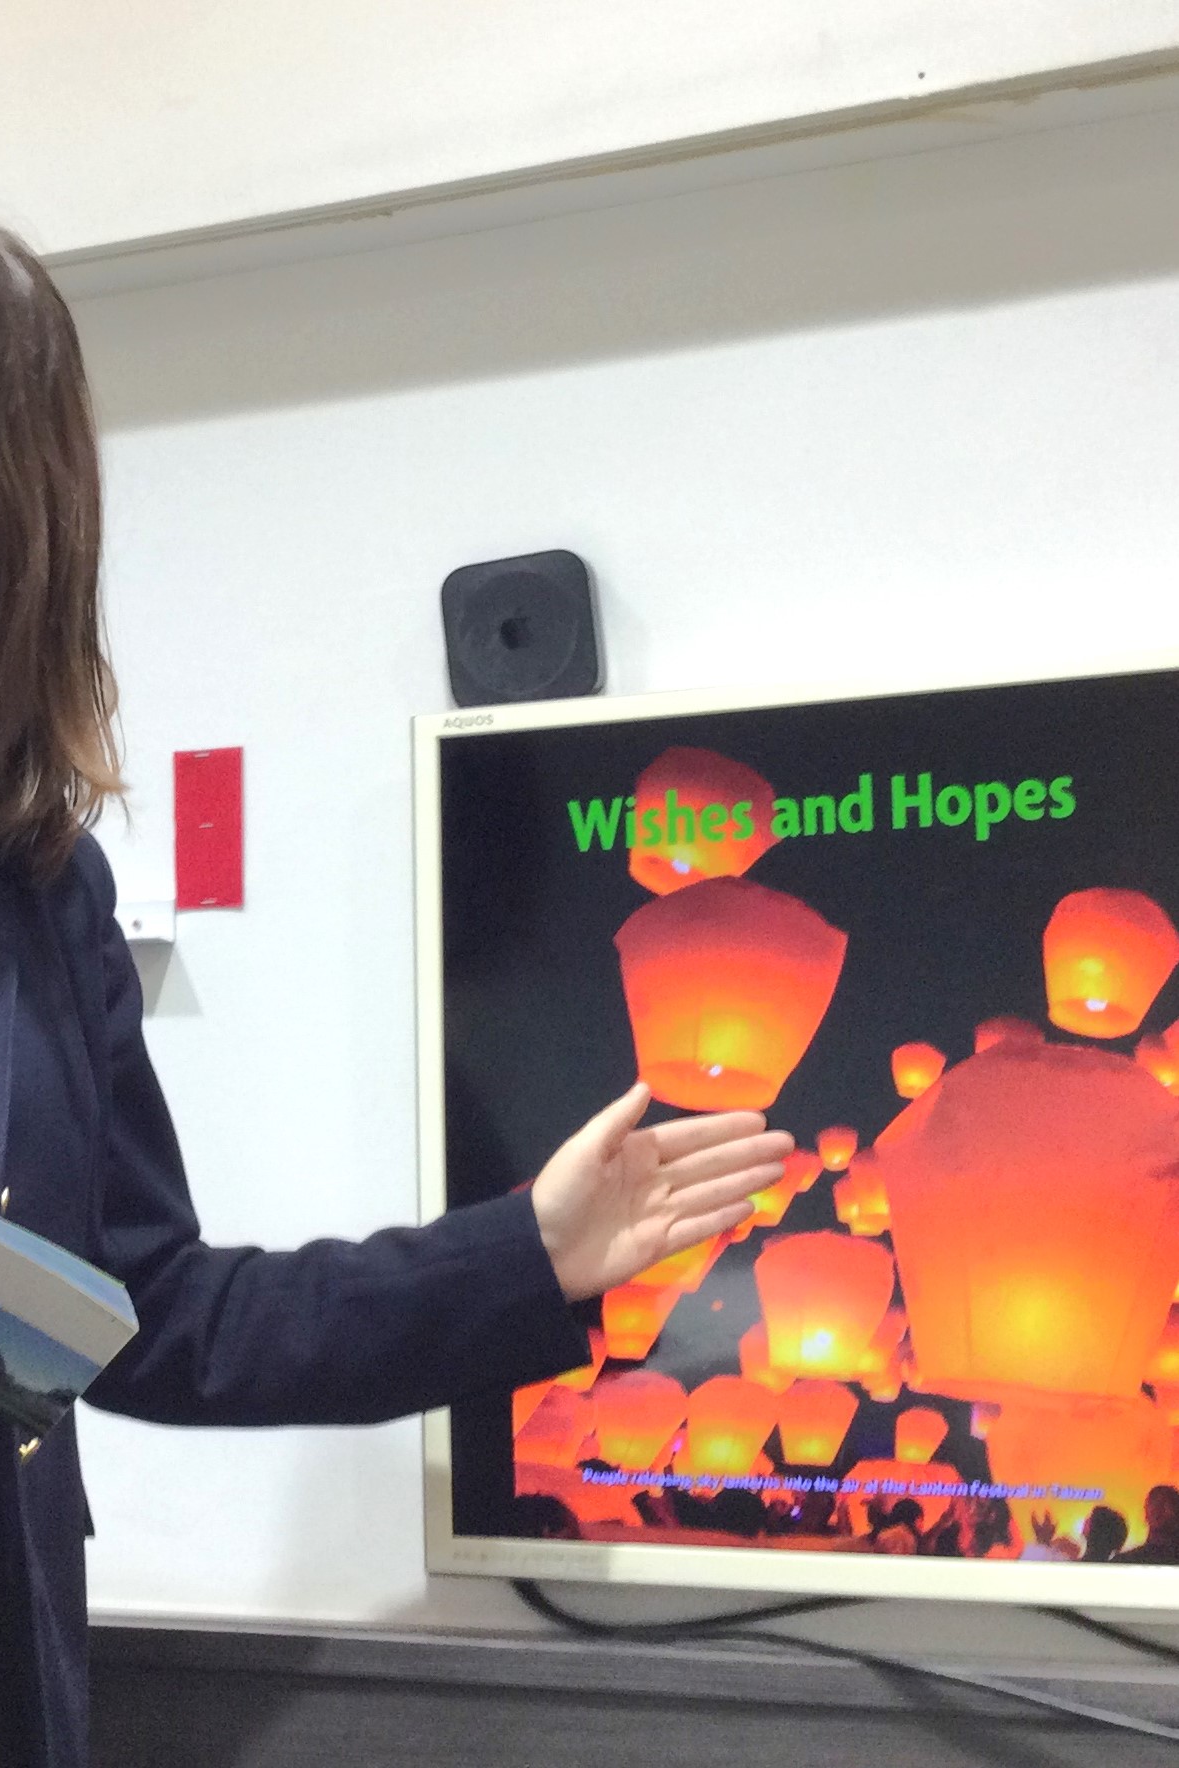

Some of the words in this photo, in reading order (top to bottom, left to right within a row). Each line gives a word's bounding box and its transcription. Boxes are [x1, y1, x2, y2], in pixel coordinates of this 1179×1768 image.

[443, 713, 494, 729] AQUOS
[567, 789, 755, 852] Wishes
[770, 772, 874, 838] and
[891, 771, 1077, 841] Hopes
[582, 1467, 629, 1486] People
[813, 1475, 839, 1493] the
[881, 1477, 907, 1495] the
[909, 1479, 968, 1497] Lantern
